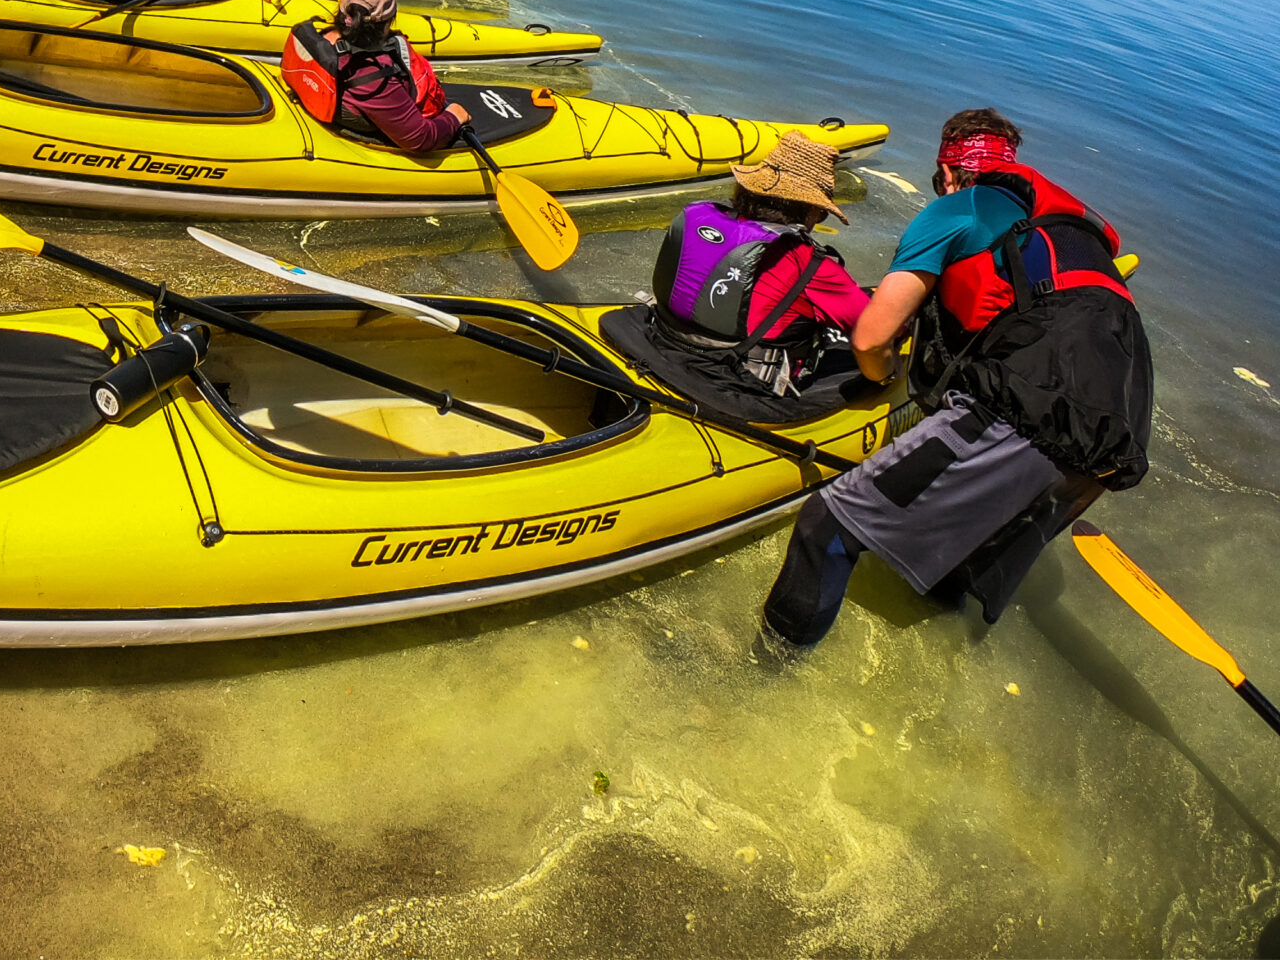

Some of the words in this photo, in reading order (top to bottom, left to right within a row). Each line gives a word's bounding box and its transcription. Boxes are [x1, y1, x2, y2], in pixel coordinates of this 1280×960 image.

[32, 143, 127, 170] Current
[127, 154, 229, 180] Designs
[350, 524, 490, 568] Current
[491, 510, 621, 551] Designs
